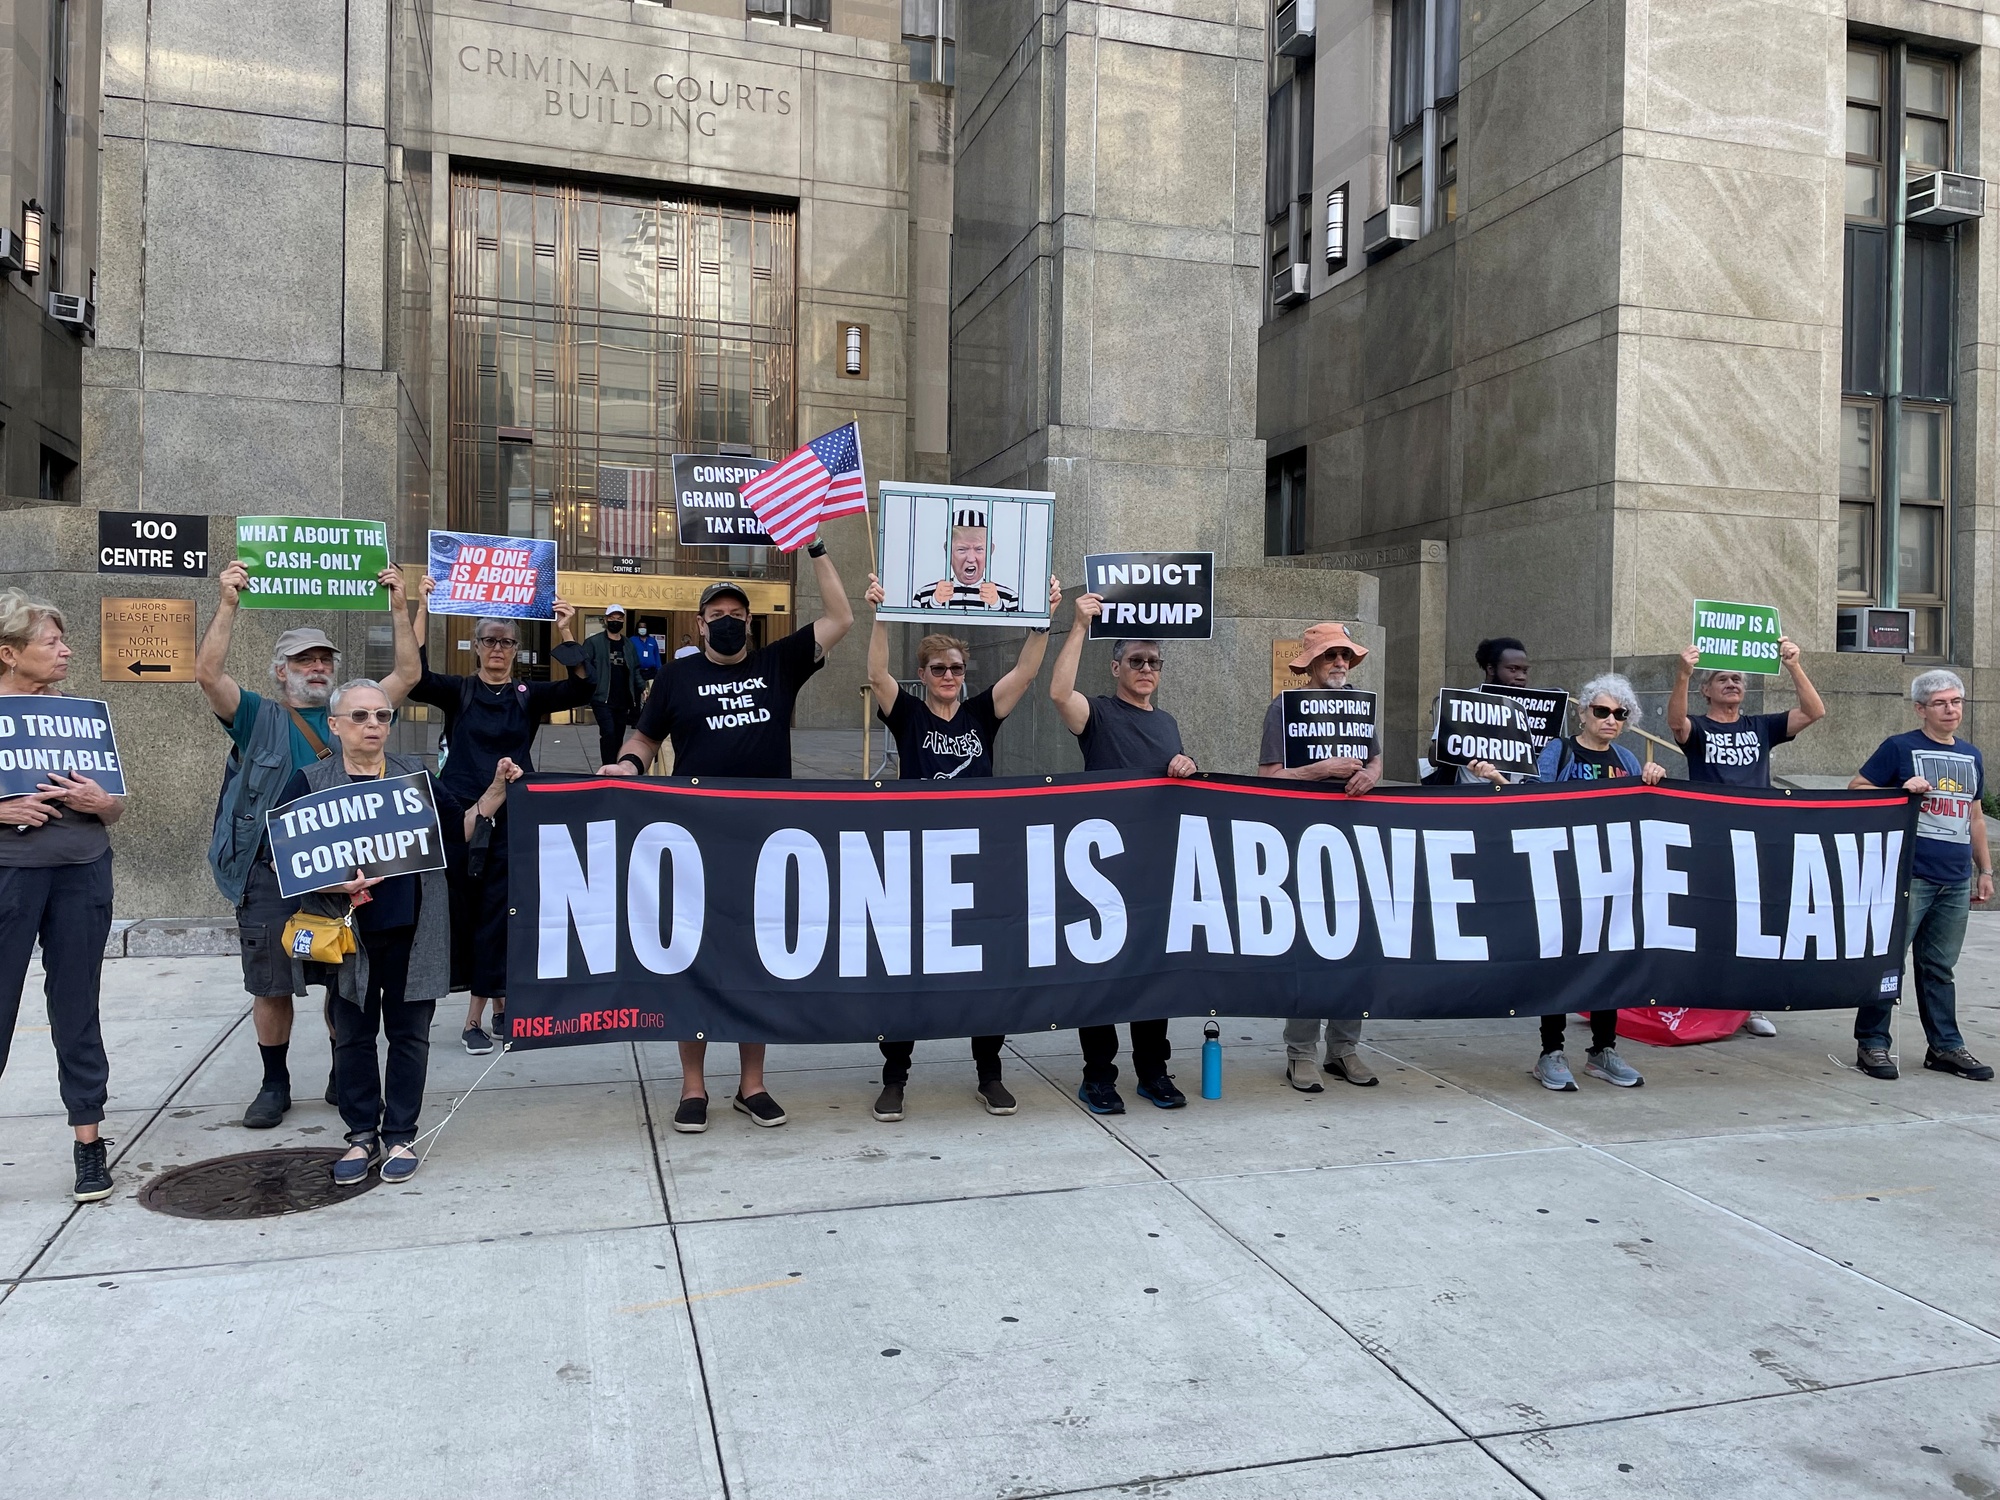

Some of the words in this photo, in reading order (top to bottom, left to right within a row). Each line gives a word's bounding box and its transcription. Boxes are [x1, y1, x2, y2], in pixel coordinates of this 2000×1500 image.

[457, 45, 638, 95] CRIMINAL
[653, 73, 792, 116] COURTS
[545, 89, 717, 137] BUILDING
[693, 465, 768, 484] CONSPIR
[682, 491, 735, 509] GRAND
[131, 520, 177, 540] 100
[705, 516, 734, 534] TAX
[738, 517, 769, 534] FRA
[240, 525, 288, 542] WHAT
[294, 526, 350, 545] ABOUT
[354, 529, 384, 546] THE
[100, 547, 173, 568] CENTRE
[183, 550, 207, 569] ST
[265, 551, 362, 571] CASH-ONLY
[459, 546, 487, 565] NO
[491, 549, 529, 568] ONE
[1306, 551, 1370, 569] TYRANNY
[450, 564, 471, 582] IS
[474, 566, 537, 586] ABOVE
[1097, 563, 1202, 586] INDICT
[249, 576, 322, 595] SKATING
[328, 580, 377, 596] RINK?
[454, 582, 488, 600] THE
[491, 585, 535, 603] LAW
[584, 582, 684, 600] ENTRANCE
[130, 603, 167, 611] JURORS
[1100, 603, 1203, 625] TRUMP
[105, 613, 148, 622] PLEASE
[154, 613, 191, 623] ENTER
[1698, 610, 1746, 631] TRUMP
[1749, 615, 1763, 633] IS
[1765, 617, 1775, 634] A
[142, 625, 155, 634] AT
[129, 637, 168, 646] NORTH
[1697, 636, 1739, 656] CRIME
[1741, 640, 1779, 660] BOSS
[118, 649, 179, 659] ENTRANCE
[698, 676, 768, 696] UNFUCK
[717, 694, 755, 710] THE
[1300, 699, 1371, 716] CONSPIRACY
[705, 708, 771, 731] WORLD
[1449, 699, 1512, 727] TRUMP
[1514, 708, 1528, 732] IS
[22, 714, 107, 740] TRUMP
[1288, 722, 1336, 738] GRAND
[1704, 730, 1733, 747] RISE
[1735, 730, 1758, 747] AND
[1307, 744, 1332, 759] TAX
[1337, 744, 1368, 760] FRAUD
[1447, 734, 1533, 765] CORRUPT
[1705, 743, 1761, 766] RESIST
[280, 792, 384, 838] TRUMP
[392, 787, 423, 816] IS
[1919, 796, 1973, 819] GUILTY
[291, 827, 429, 879] CORRUPT
[536, 818, 706, 980] NO
[753, 827, 984, 980] ONE
[1026, 818, 1128, 969] IS
[1165, 813, 1489, 962] ABOVE
[1511, 818, 1697, 959] THE
[1729, 828, 1904, 962] LAW
[294, 942, 310, 955] LIES
[1880, 982, 1898, 993] RESIST
